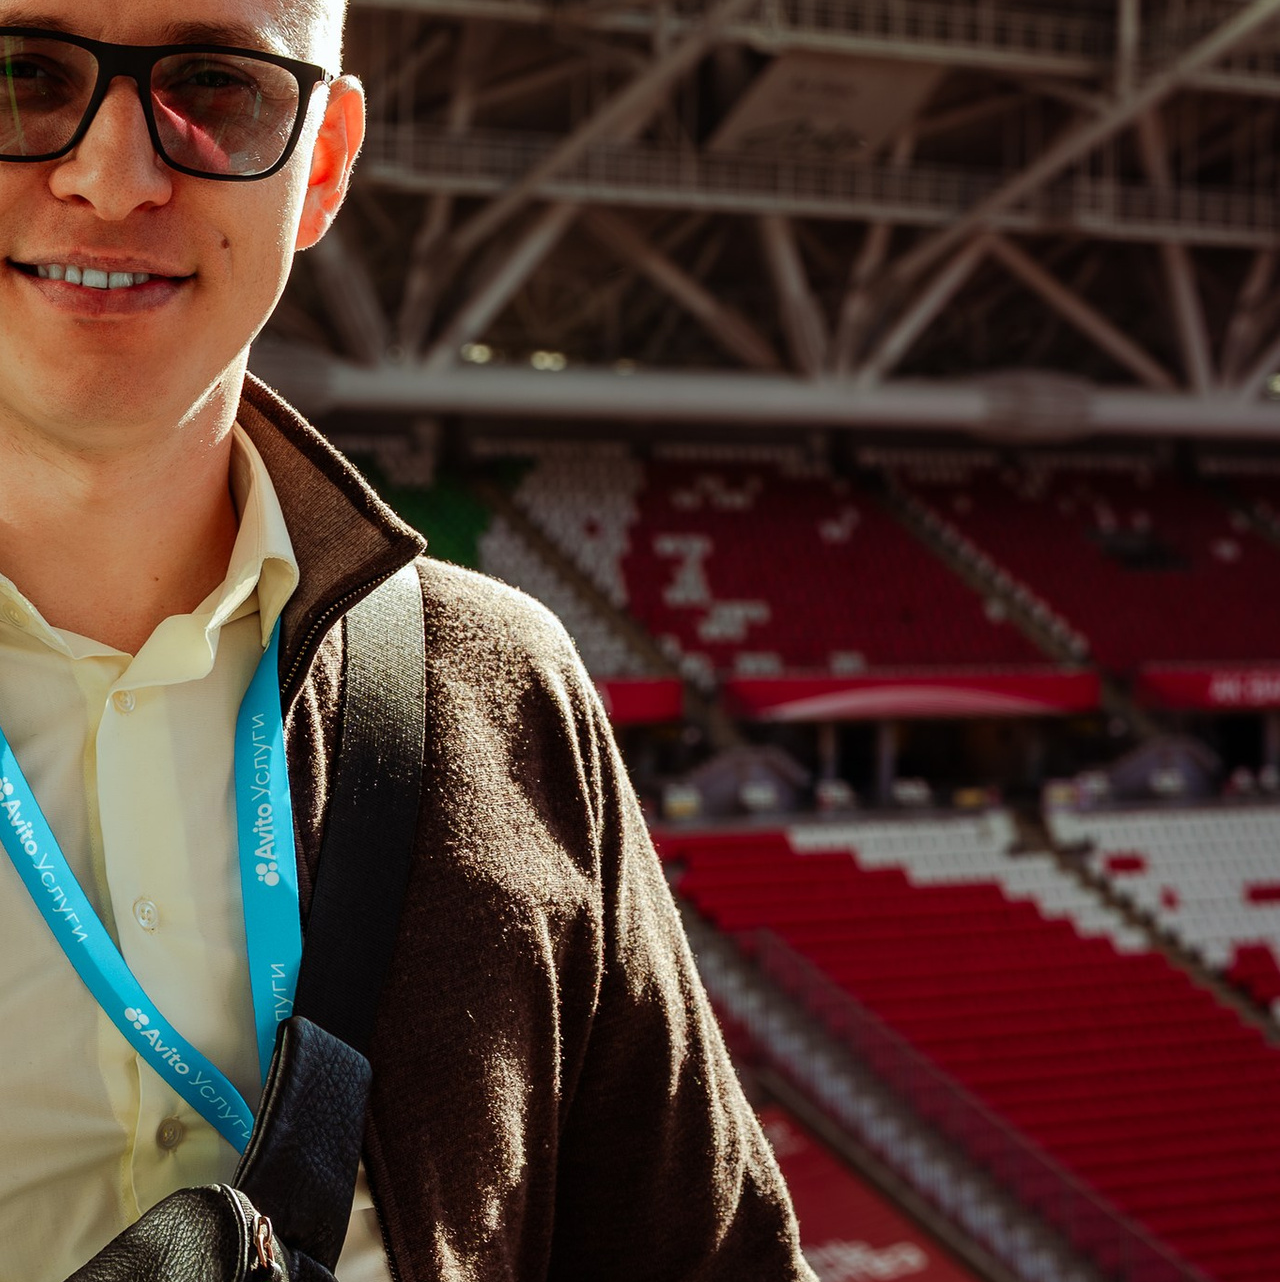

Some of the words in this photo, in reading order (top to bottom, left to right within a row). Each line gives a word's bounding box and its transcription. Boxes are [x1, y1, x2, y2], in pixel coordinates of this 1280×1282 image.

[250, 713, 272, 802] Услуги
[252, 803, 277, 860] Avito
[1, 799, 38, 856] Avito
[33, 852, 89, 943] Услуги
[271, 963, 294, 1022] луги
[140, 1028, 190, 1075] Avito
